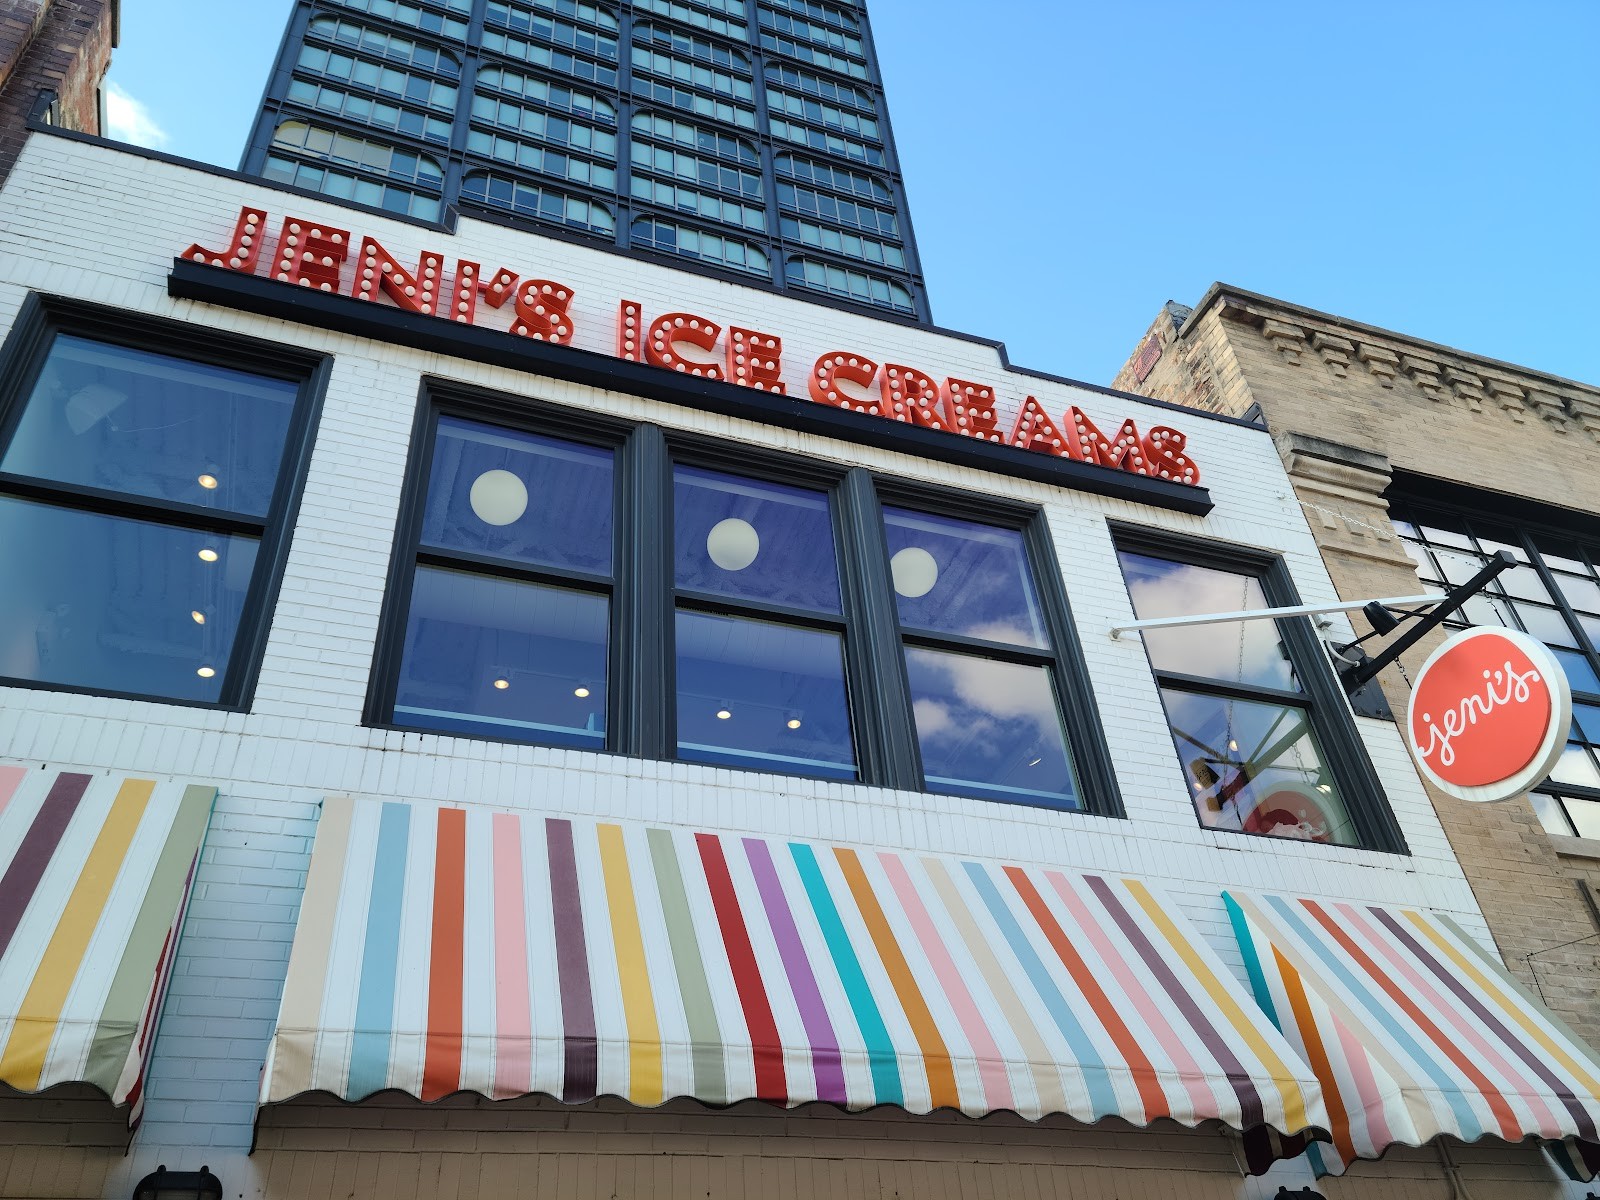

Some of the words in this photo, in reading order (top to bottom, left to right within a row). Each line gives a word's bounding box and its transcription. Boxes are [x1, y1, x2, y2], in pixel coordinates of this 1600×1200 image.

[180, 206, 575, 347] JENI'S
[620, 300, 786, 396] ICE
[808, 350, 1201, 486] CREAMS
[1417, 660, 1541, 766] jeni's
